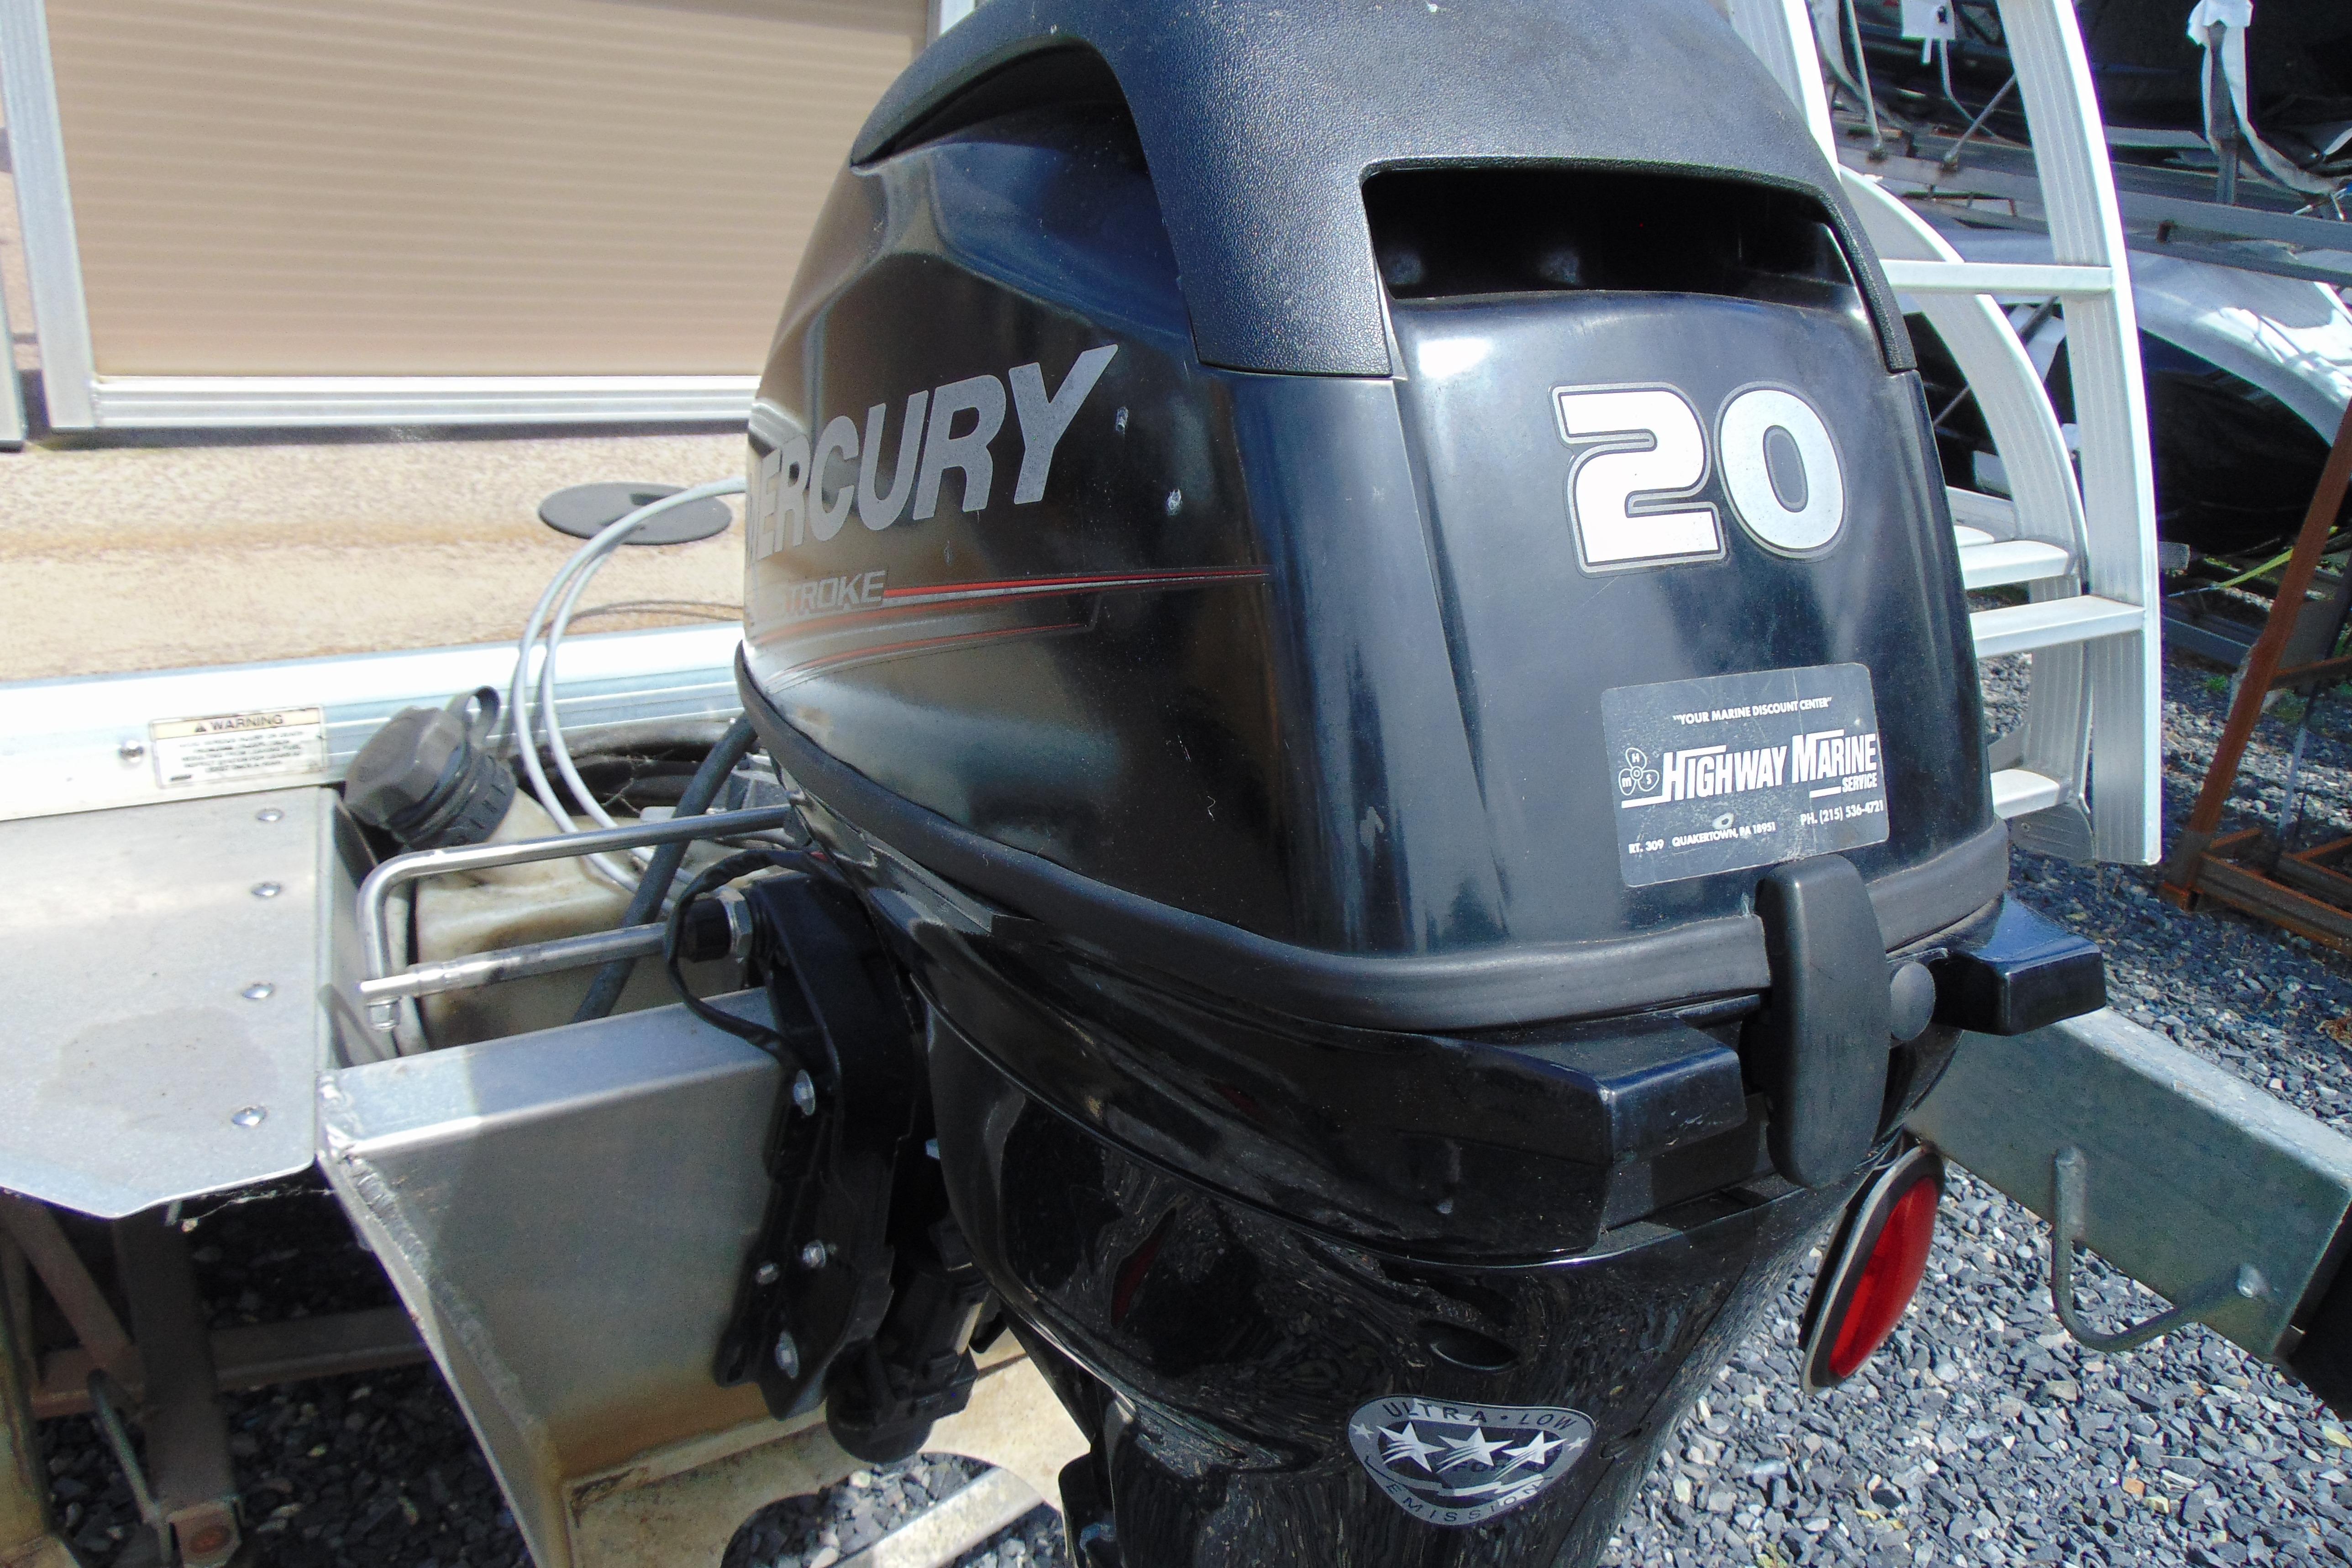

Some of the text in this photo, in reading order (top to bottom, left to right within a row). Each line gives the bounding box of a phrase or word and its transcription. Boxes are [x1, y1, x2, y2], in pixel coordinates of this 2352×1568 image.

[1550, 381, 1848, 574] 20
[210, 715, 284, 730] WARNING
[1673, 697, 1832, 725] "YOUR MARINE DISCOUNT CENTER"
[1663, 729, 1877, 802] HIGHWAY MARINE
[1842, 772, 1878, 793] SERVICE
[1800, 800, 1884, 826] PH. (215) 536-4721
[1628, 822, 1776, 854] RT. 309 QUAKERTOWN, PA 18951
[1386, 1483, 1540, 1522] EMISSION
